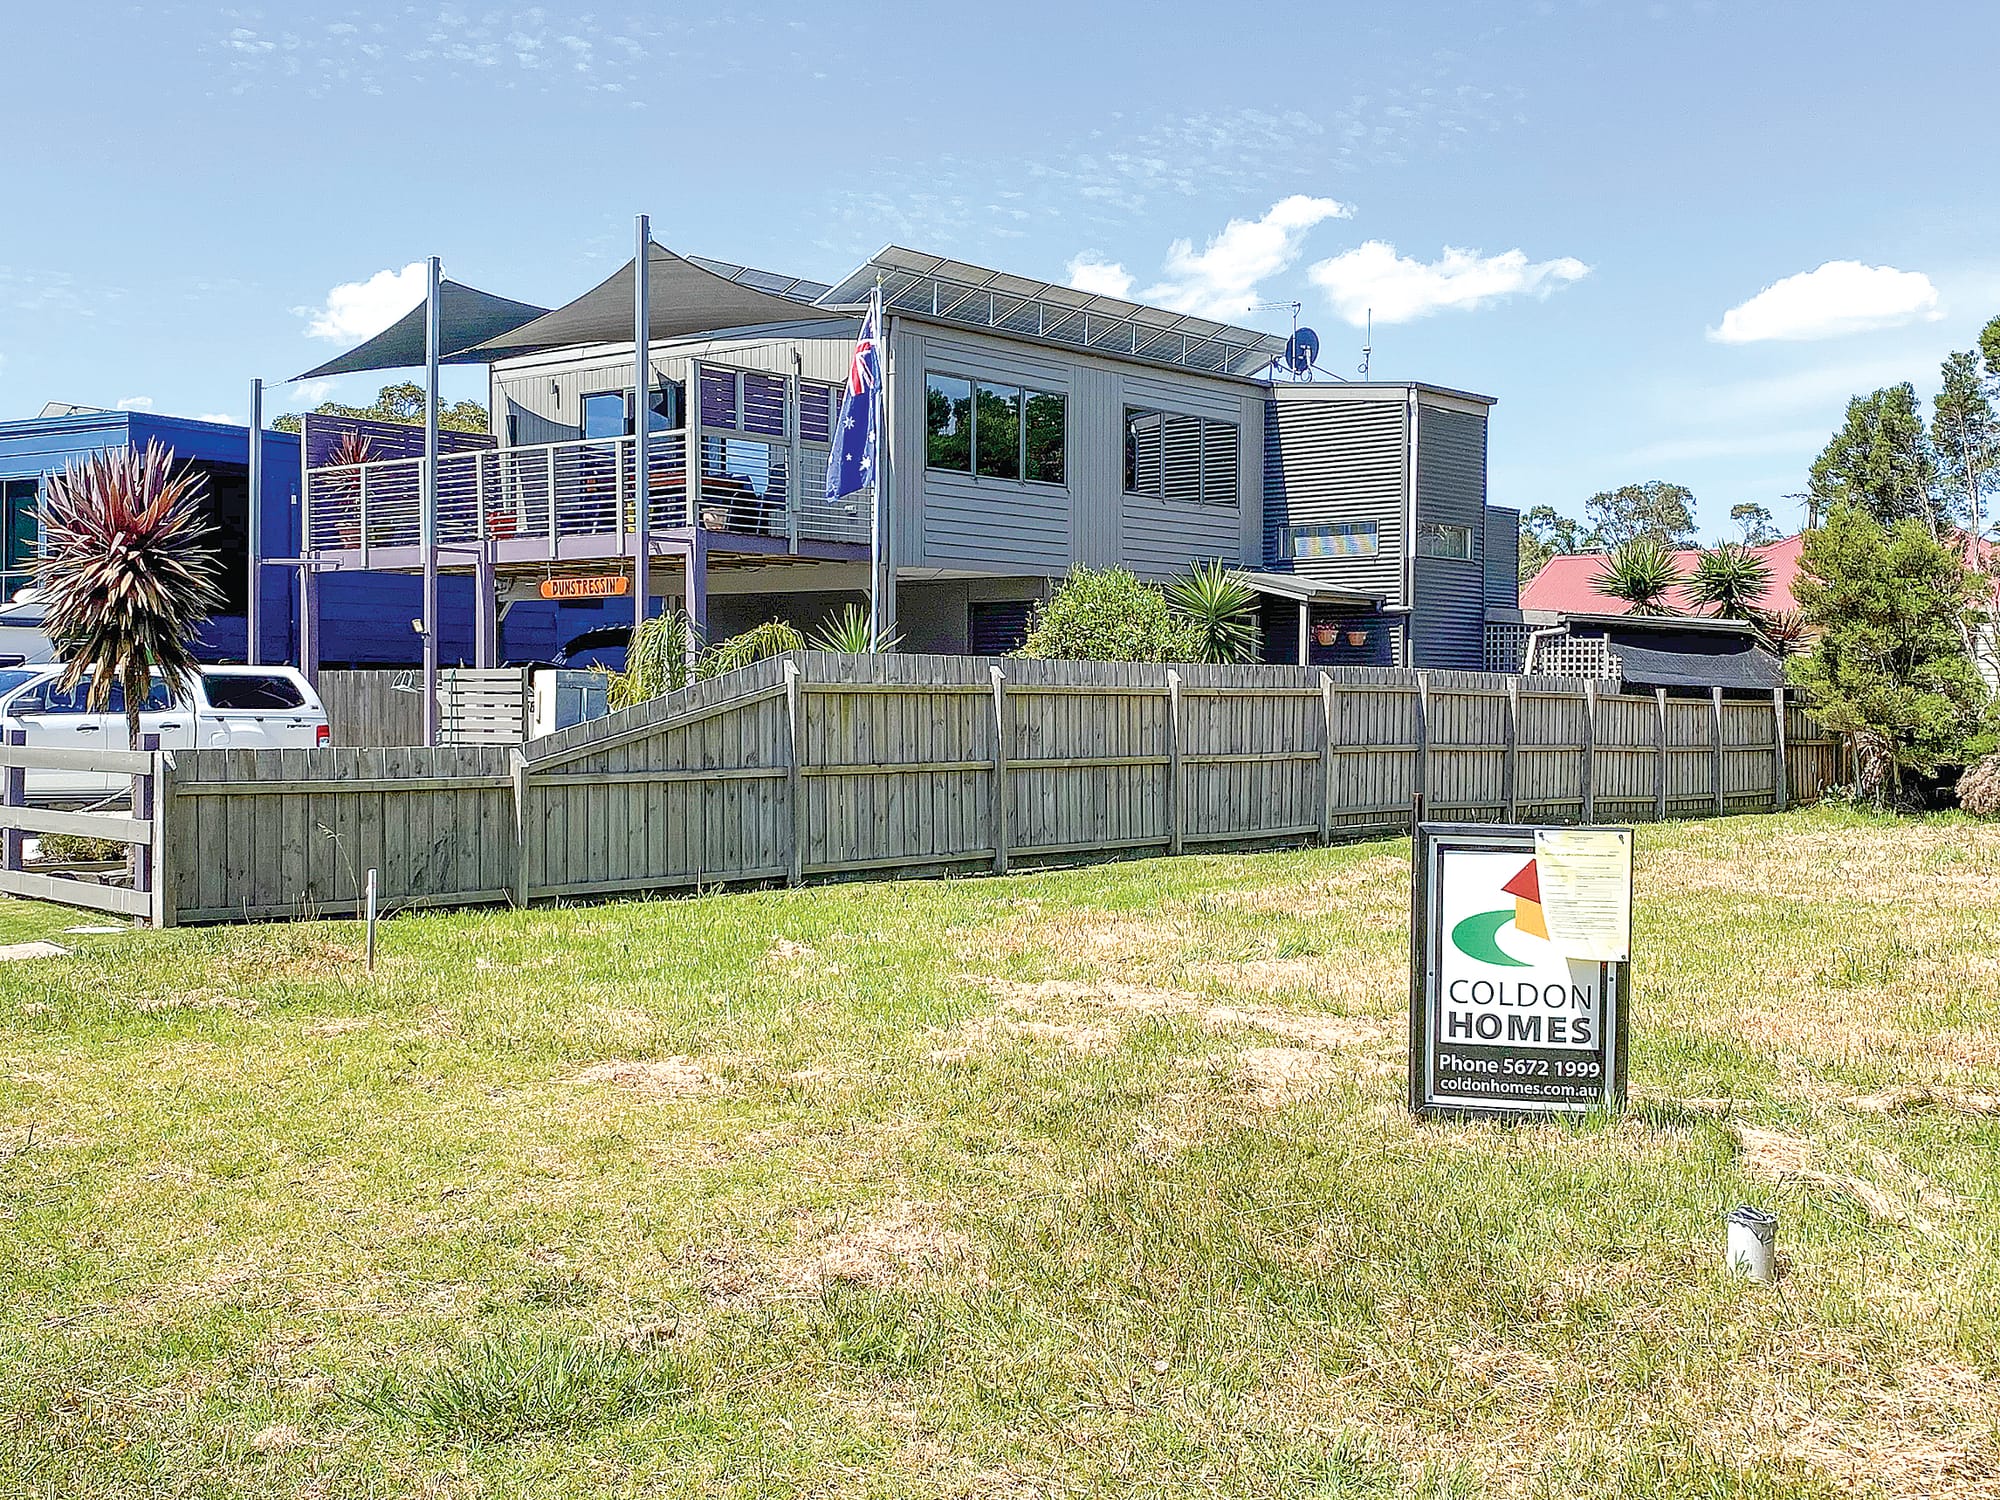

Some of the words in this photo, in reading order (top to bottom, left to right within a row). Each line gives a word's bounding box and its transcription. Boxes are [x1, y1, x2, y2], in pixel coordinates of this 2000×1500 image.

[1450, 979, 1592, 1010] COLDON
[1448, 1011, 1592, 1044] HOMES
[1439, 1054, 1498, 1074] Phone
[1502, 1058, 1549, 1076] 5672
[1555, 1061, 1600, 1078] 1999
[1440, 1077, 1598, 1098] coldonhomes.com.au
